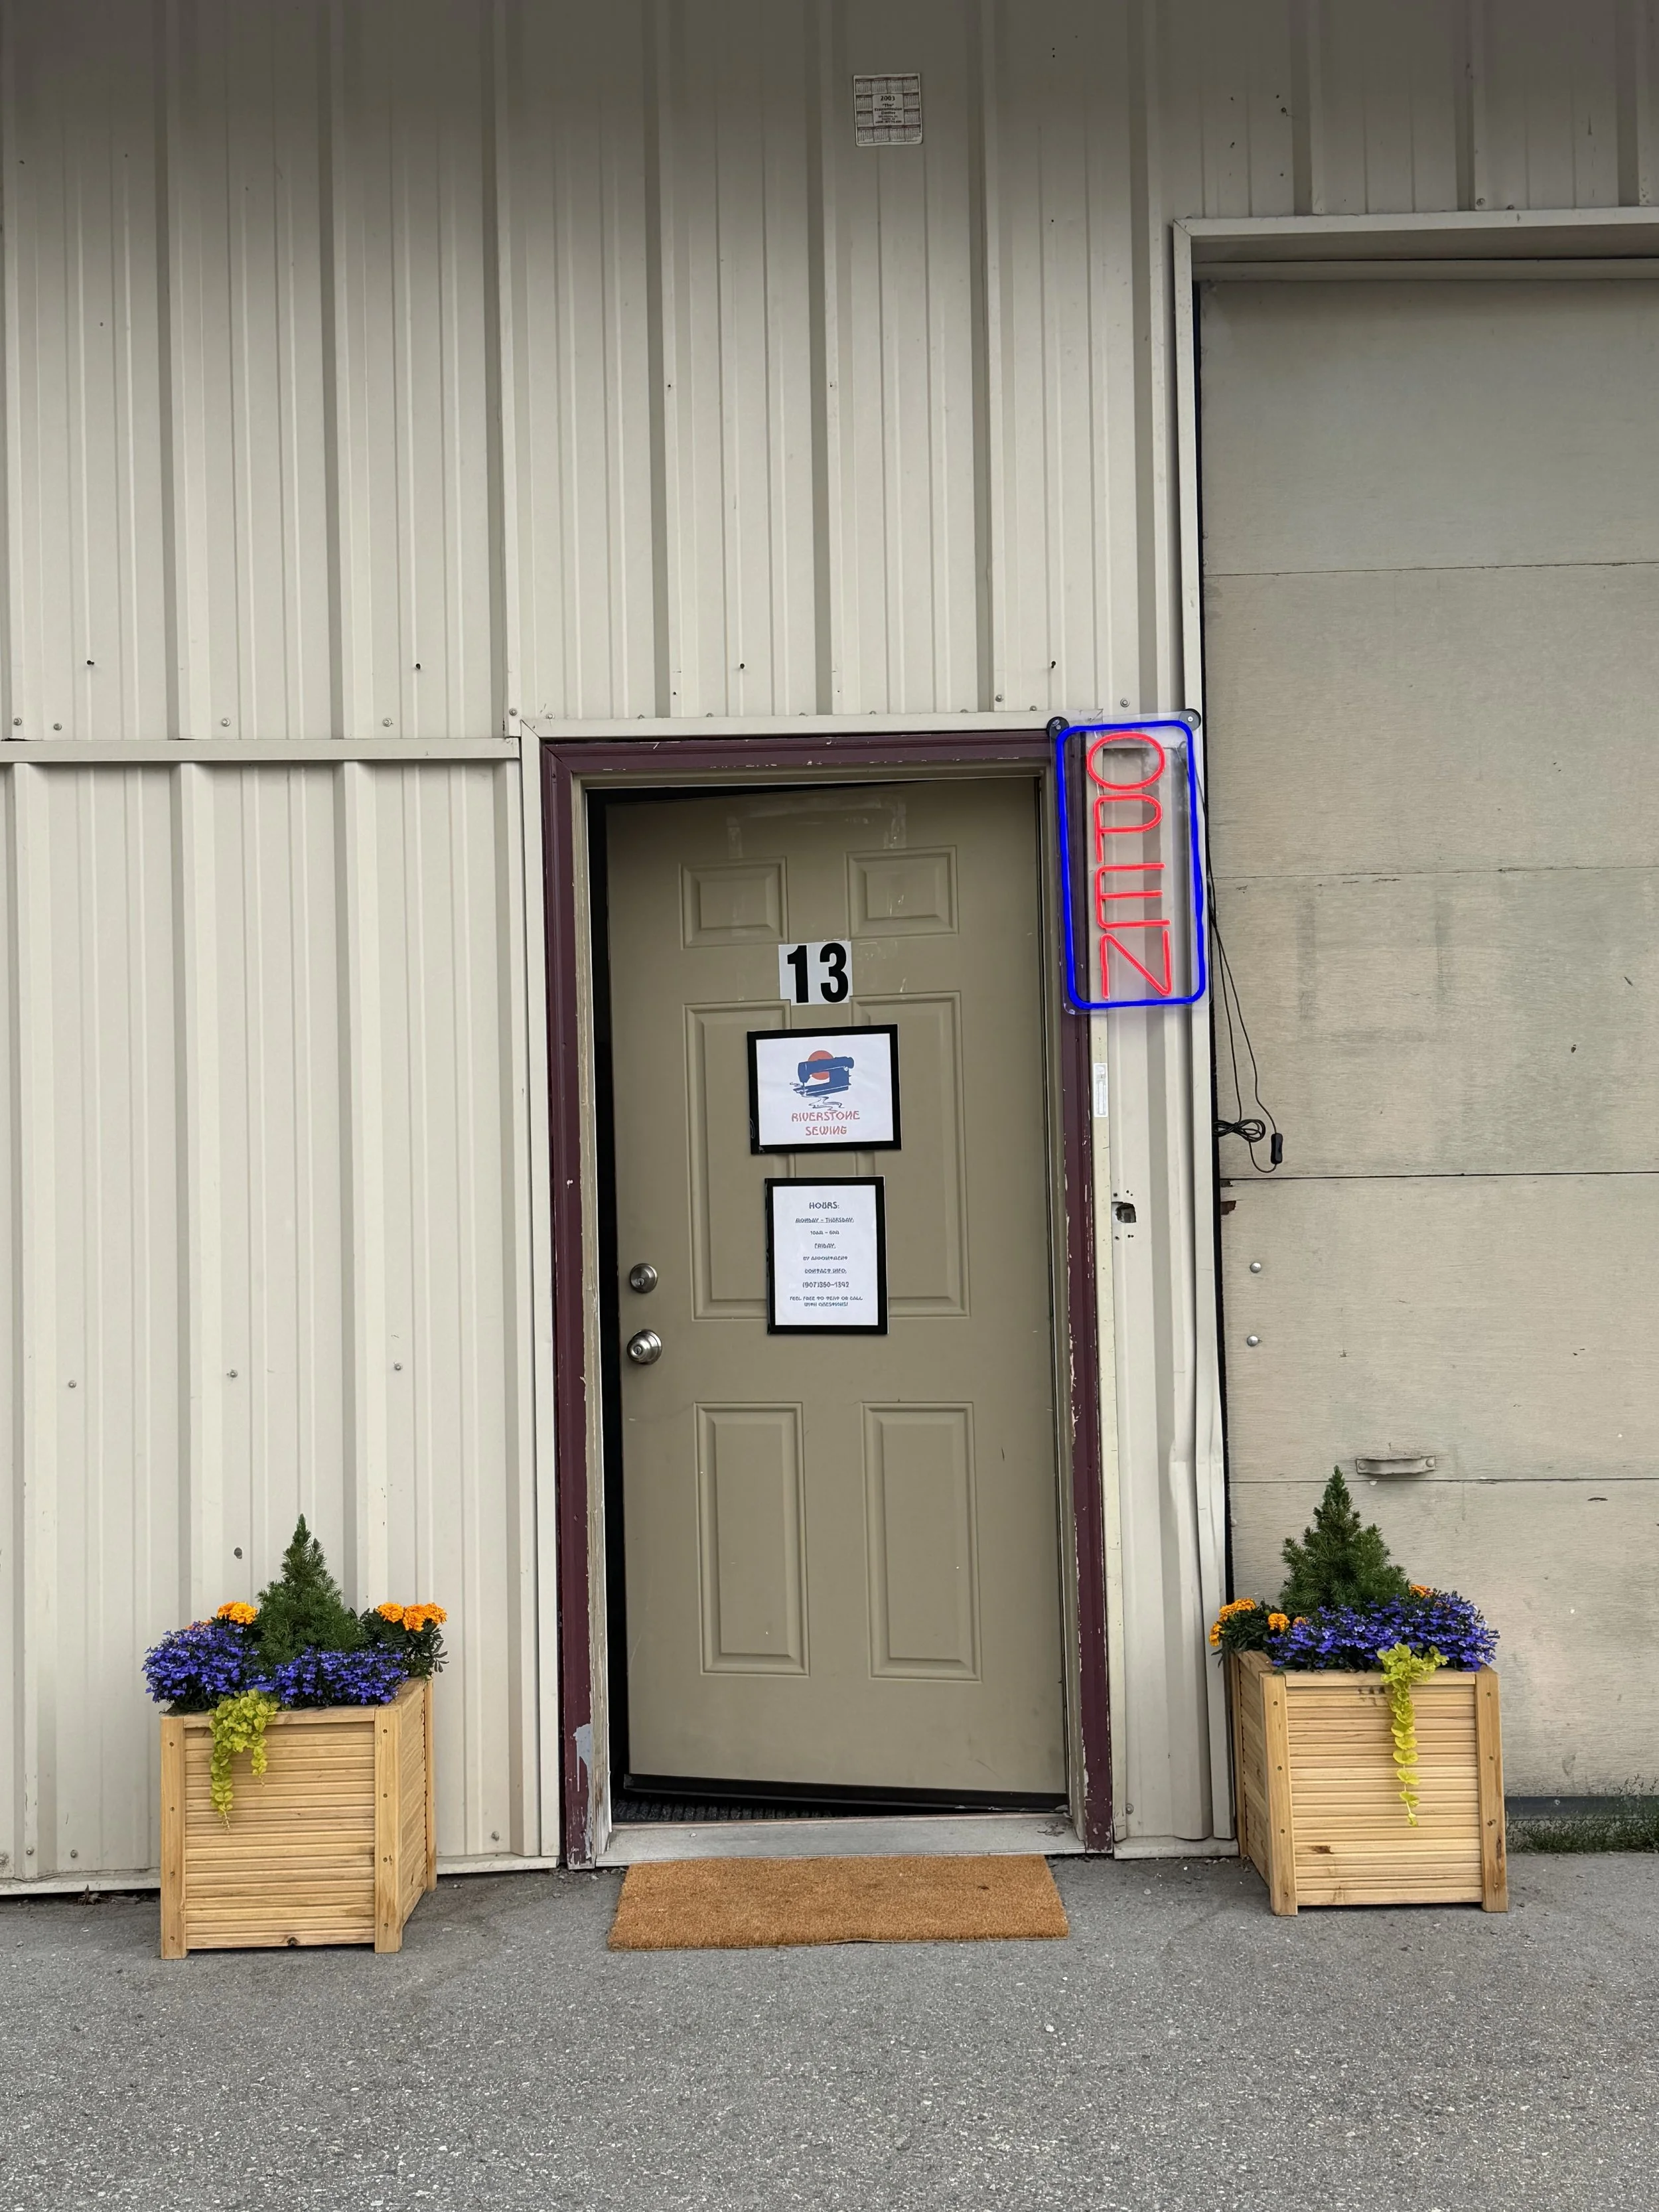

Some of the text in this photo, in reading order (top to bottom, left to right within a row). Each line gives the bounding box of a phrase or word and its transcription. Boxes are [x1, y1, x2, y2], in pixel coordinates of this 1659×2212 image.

[1086, 730, 1173, 999] OPEN
[787, 942, 849, 1003] 13
[791, 1110, 861, 1122] RIVERSTONE
[805, 1126, 847, 1136] SEWING
